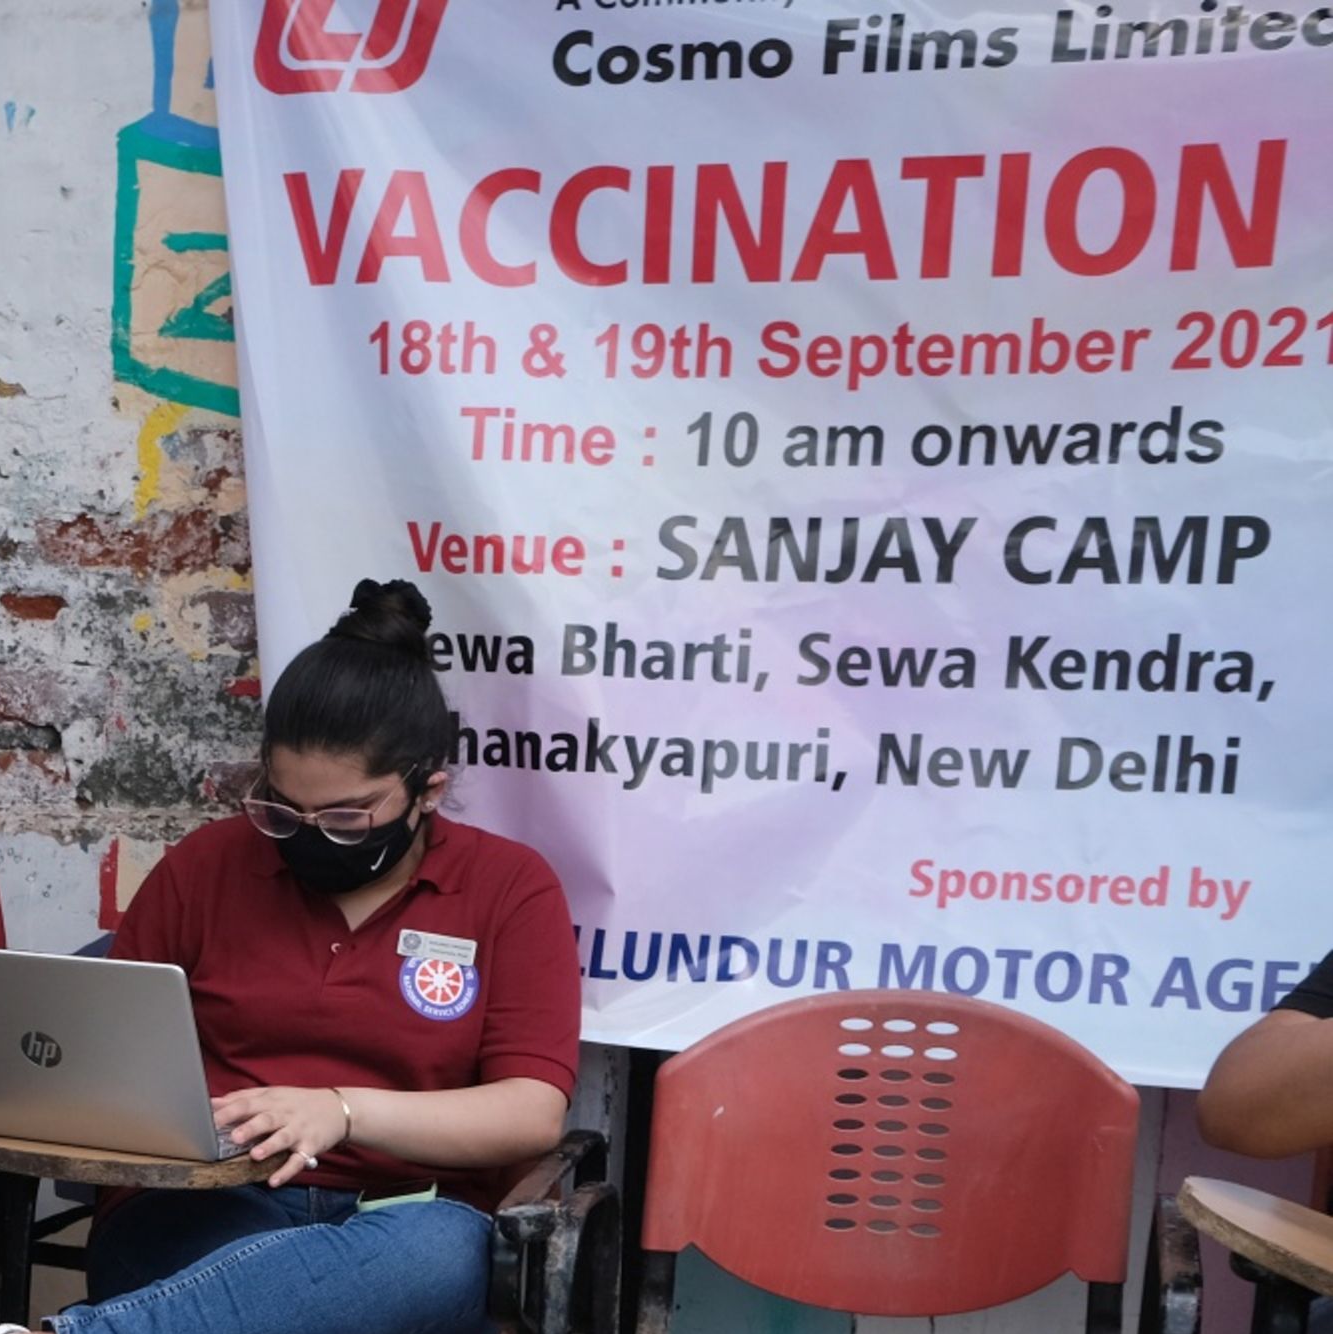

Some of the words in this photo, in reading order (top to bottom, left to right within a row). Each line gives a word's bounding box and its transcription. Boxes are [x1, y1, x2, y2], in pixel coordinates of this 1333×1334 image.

[552, 29, 794, 87] Cosmo
[822, 13, 1020, 75] Films
[282, 138, 1288, 288] VACCINATION
[369, 319, 497, 376] 18th
[521, 323, 568, 379] &
[595, 322, 732, 379] 19th
[758, 318, 1152, 392] September
[460, 407, 616, 465] Time
[686, 411, 759, 467] 10
[783, 424, 884, 467] am
[911, 405, 1225, 467] onwards
[407, 521, 586, 577] Venue
[656, 514, 978, 584] SANJAY
[1003, 515, 1272, 585] CAMP
[431, 630, 535, 675] ewa
[560, 621, 769, 692] Bharti,
[796, 632, 977, 689] Sewa
[1004, 633, 1276, 703] Kendra,
[447, 711, 848, 793] hanakyapuri,
[876, 732, 1031, 790] New
[1054, 735, 1241, 795] Delhi
[908, 858, 1171, 909] Sponsored
[1187, 866, 1253, 921] by
[877, 942, 1131, 1007] MOTOR
[1150, 956, 1321, 1014] AGE
[25, 1031, 58, 1069] hp
